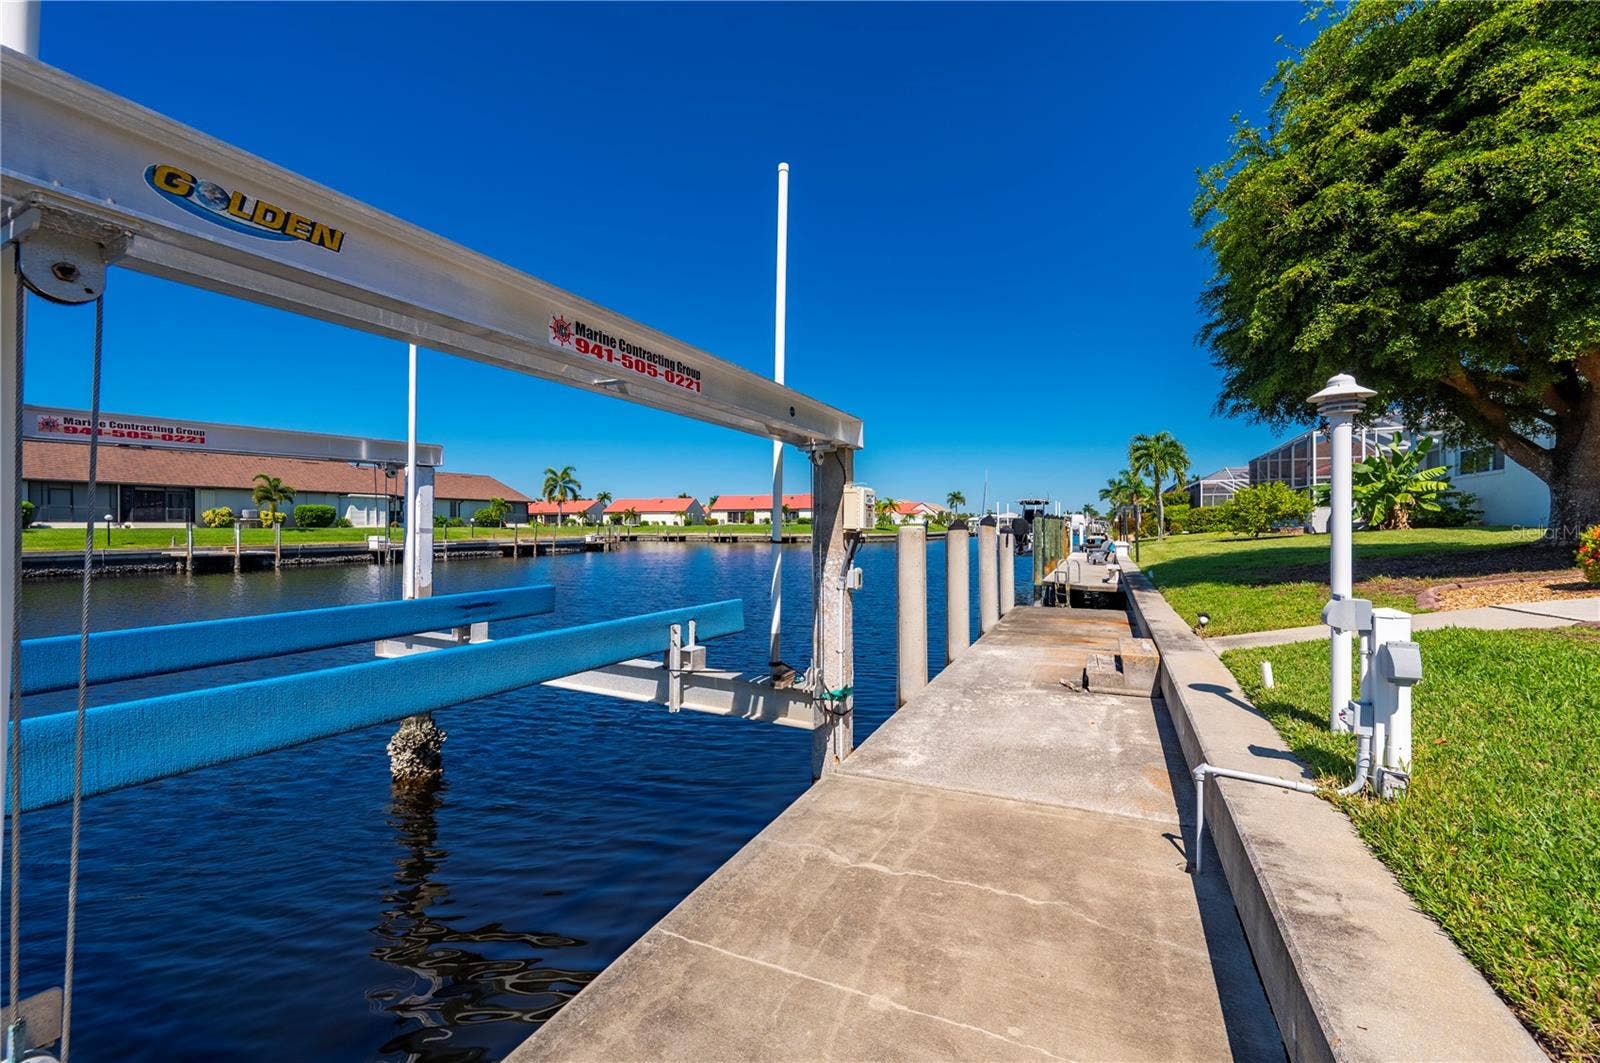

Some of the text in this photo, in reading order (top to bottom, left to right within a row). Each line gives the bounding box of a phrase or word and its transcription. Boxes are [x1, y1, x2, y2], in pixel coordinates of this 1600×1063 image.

[153, 164, 344, 253] GOLDEN
[574, 320, 617, 349] Marine
[618, 338, 675, 371] Contracting
[676, 361, 701, 380] Group
[575, 337, 701, 393] 941-505-0221
[63, 416, 106, 428] Marie
[109, 420, 173, 434] Contracting
[176, 426, 205, 437] Group
